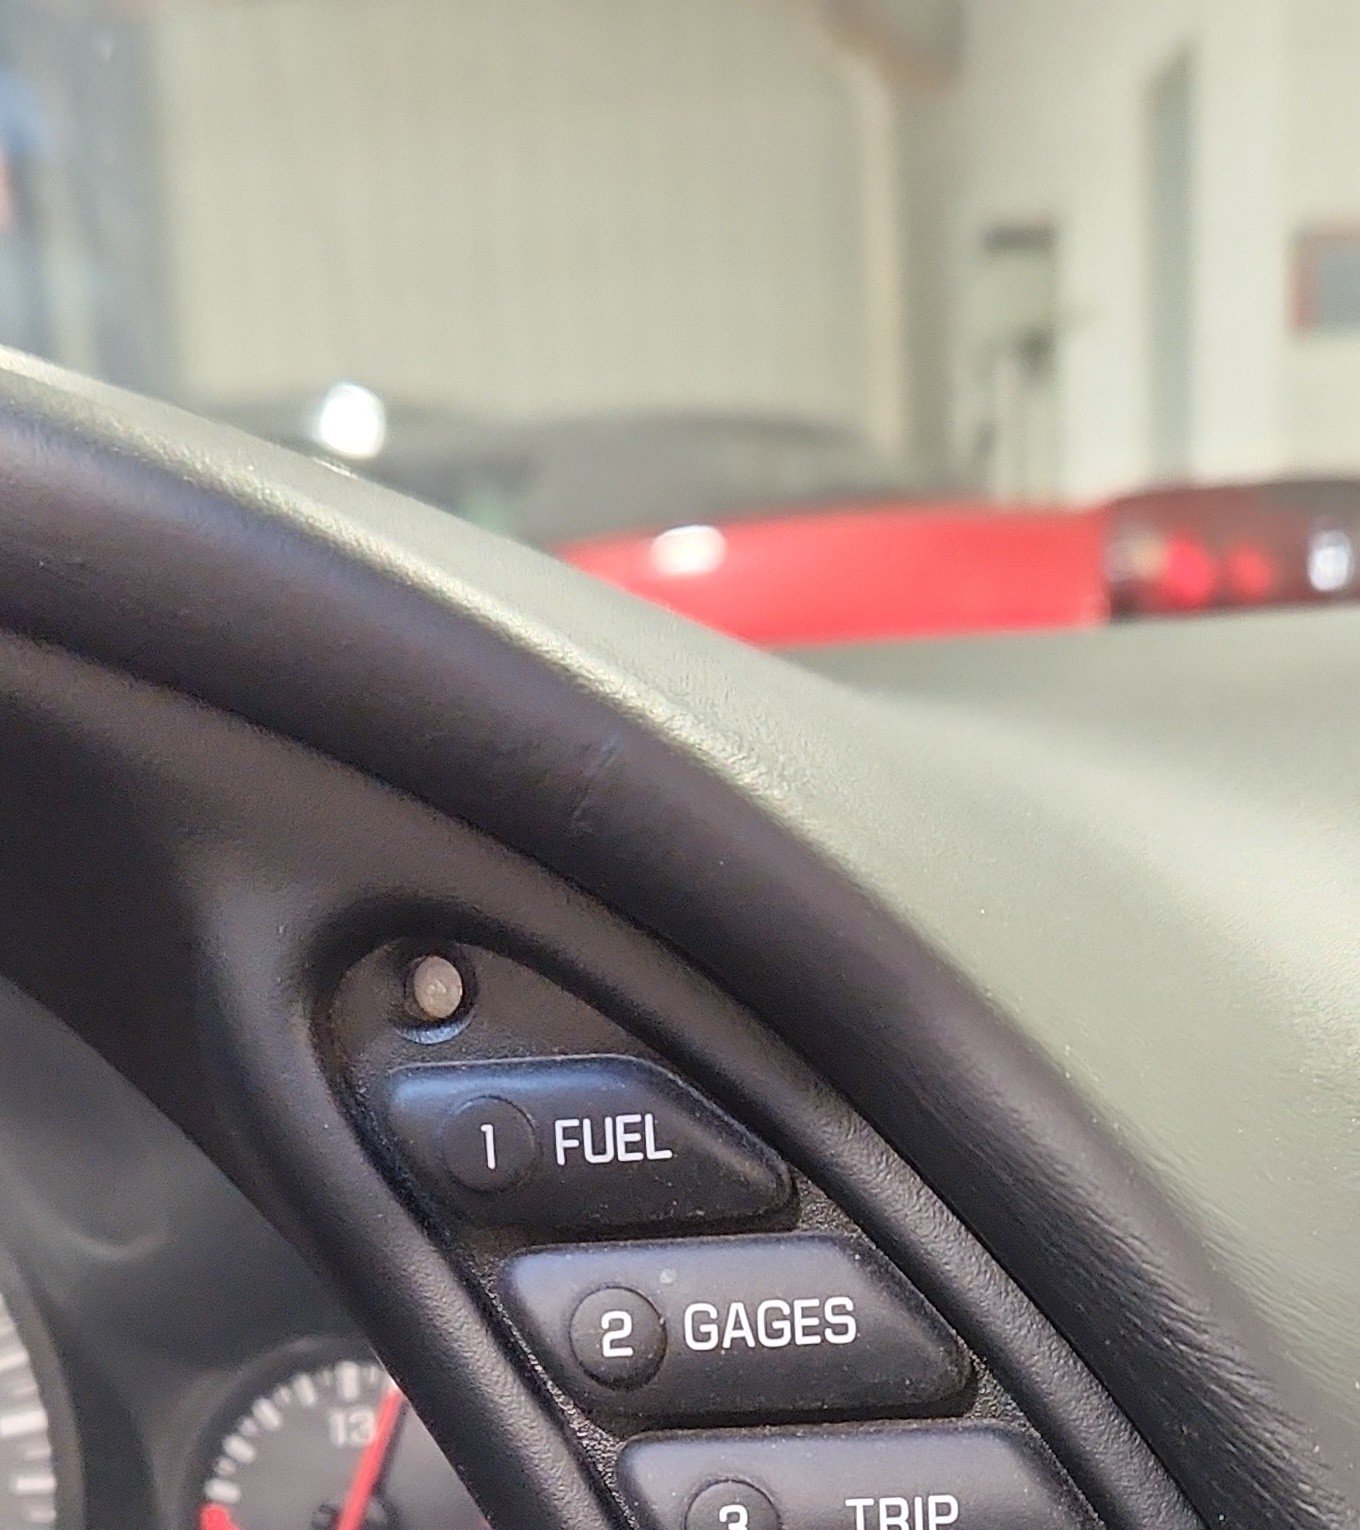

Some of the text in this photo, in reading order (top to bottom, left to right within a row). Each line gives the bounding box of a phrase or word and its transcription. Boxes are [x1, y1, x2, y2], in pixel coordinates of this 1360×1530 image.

[479, 1112, 674, 1170] 1 FUEL
[598, 1296, 858, 1359] 2 GAGES
[327, 1405, 377, 1448] 13
